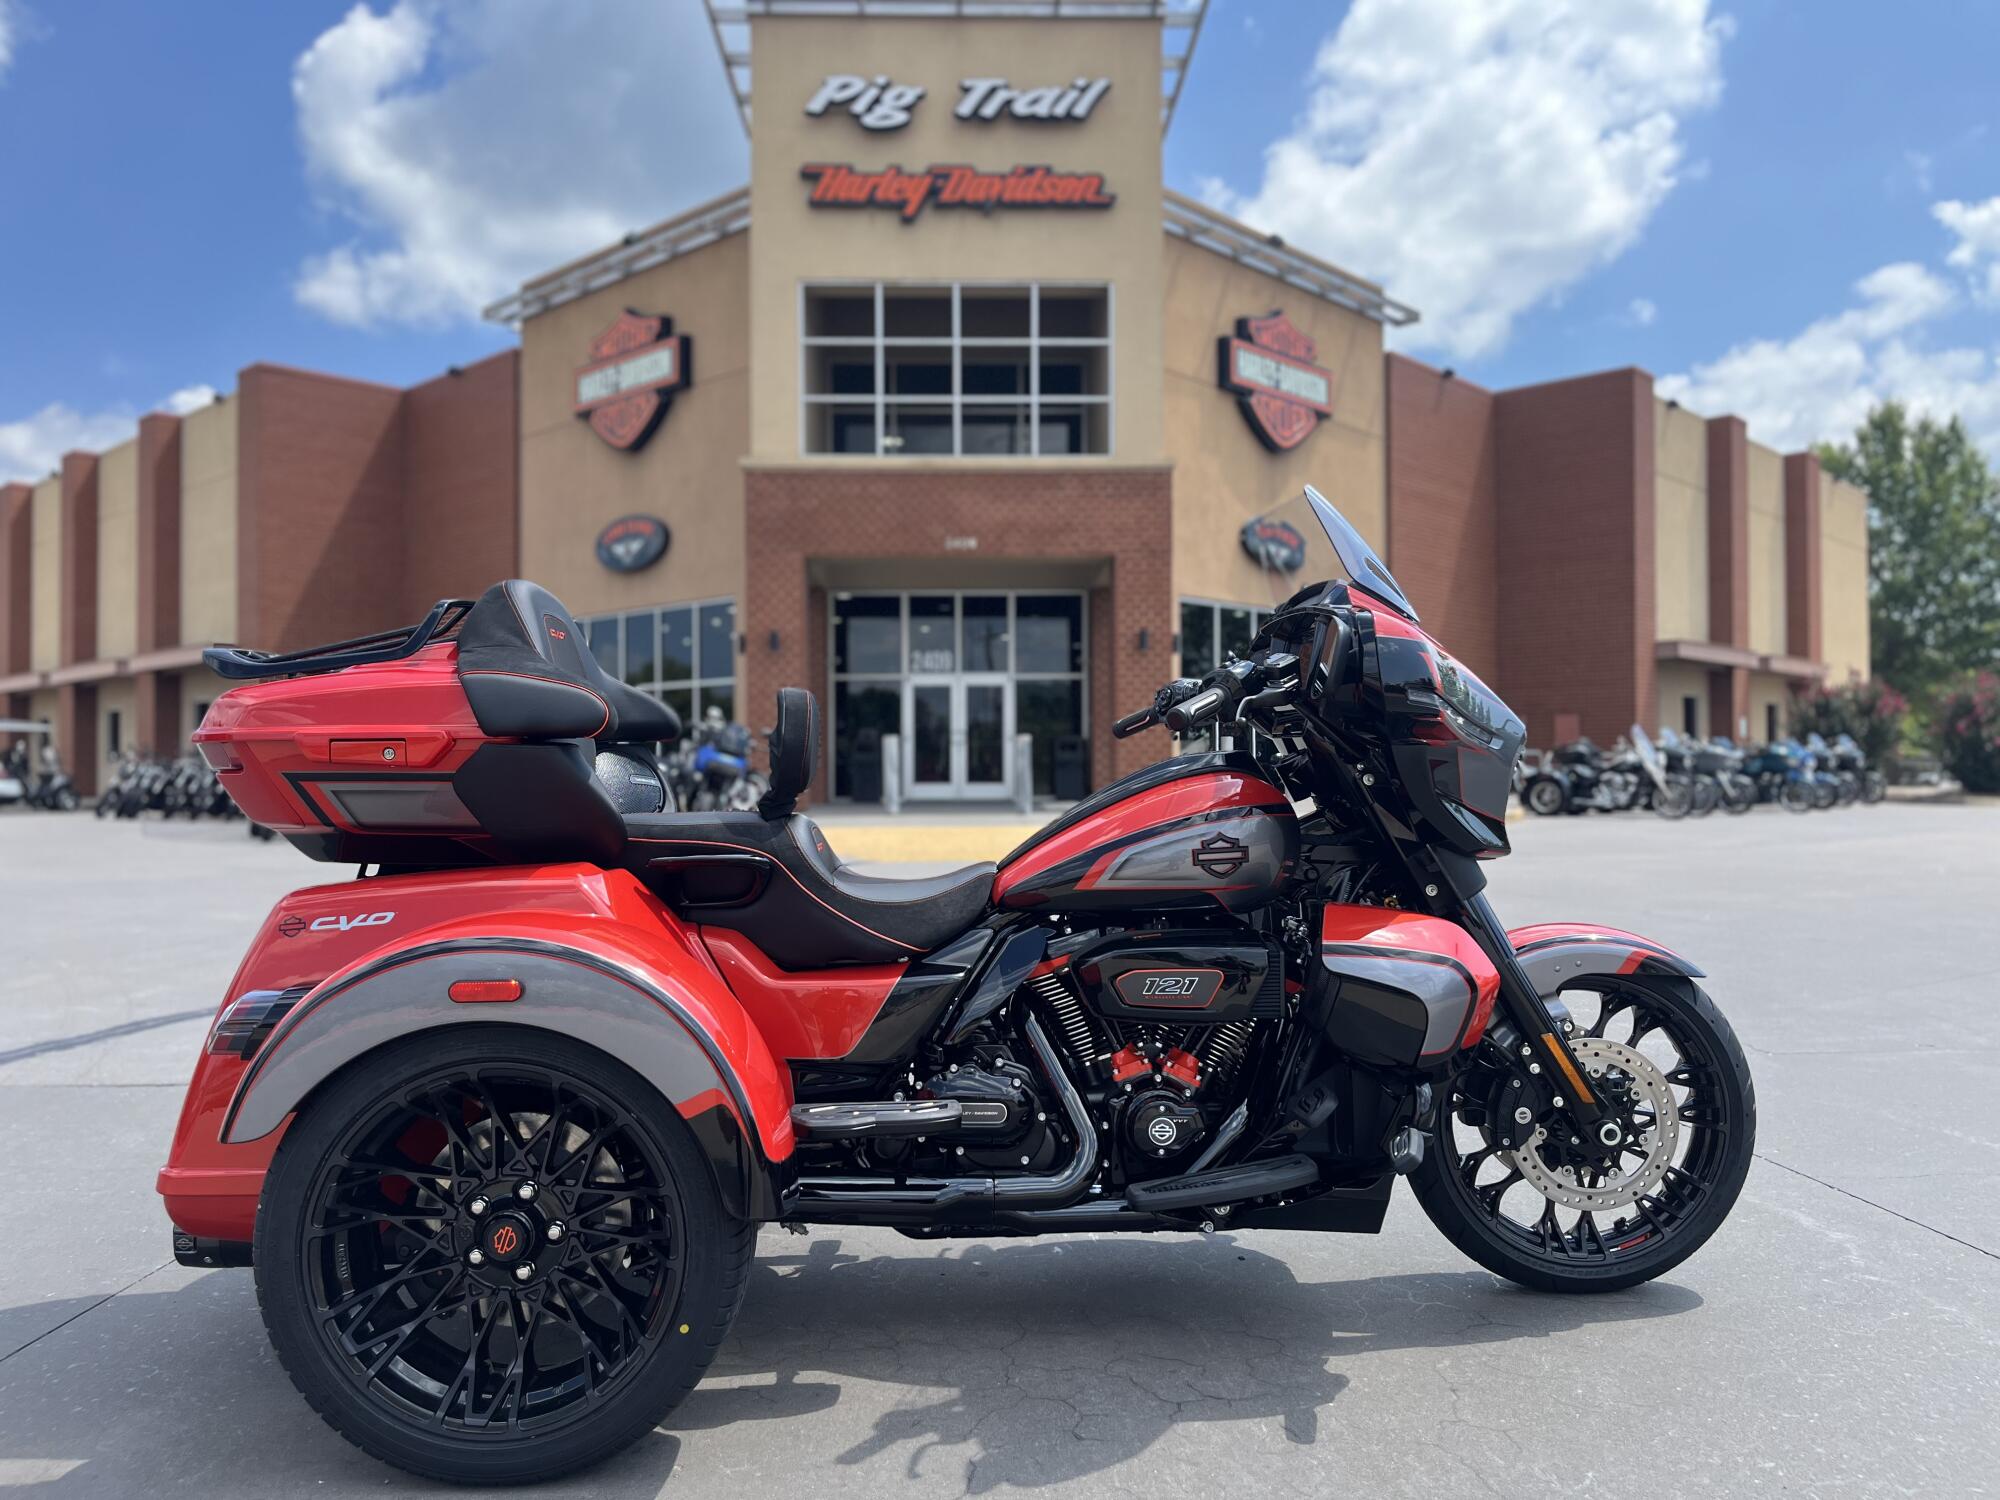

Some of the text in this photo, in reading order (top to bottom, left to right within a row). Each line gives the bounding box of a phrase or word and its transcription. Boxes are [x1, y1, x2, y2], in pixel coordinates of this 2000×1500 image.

[804, 73, 1112, 131] Pig Trail
[800, 163, 1116, 222] Harley-Davidson
[310, 911, 396, 931] CVO
[1142, 977, 1199, 995] 121
